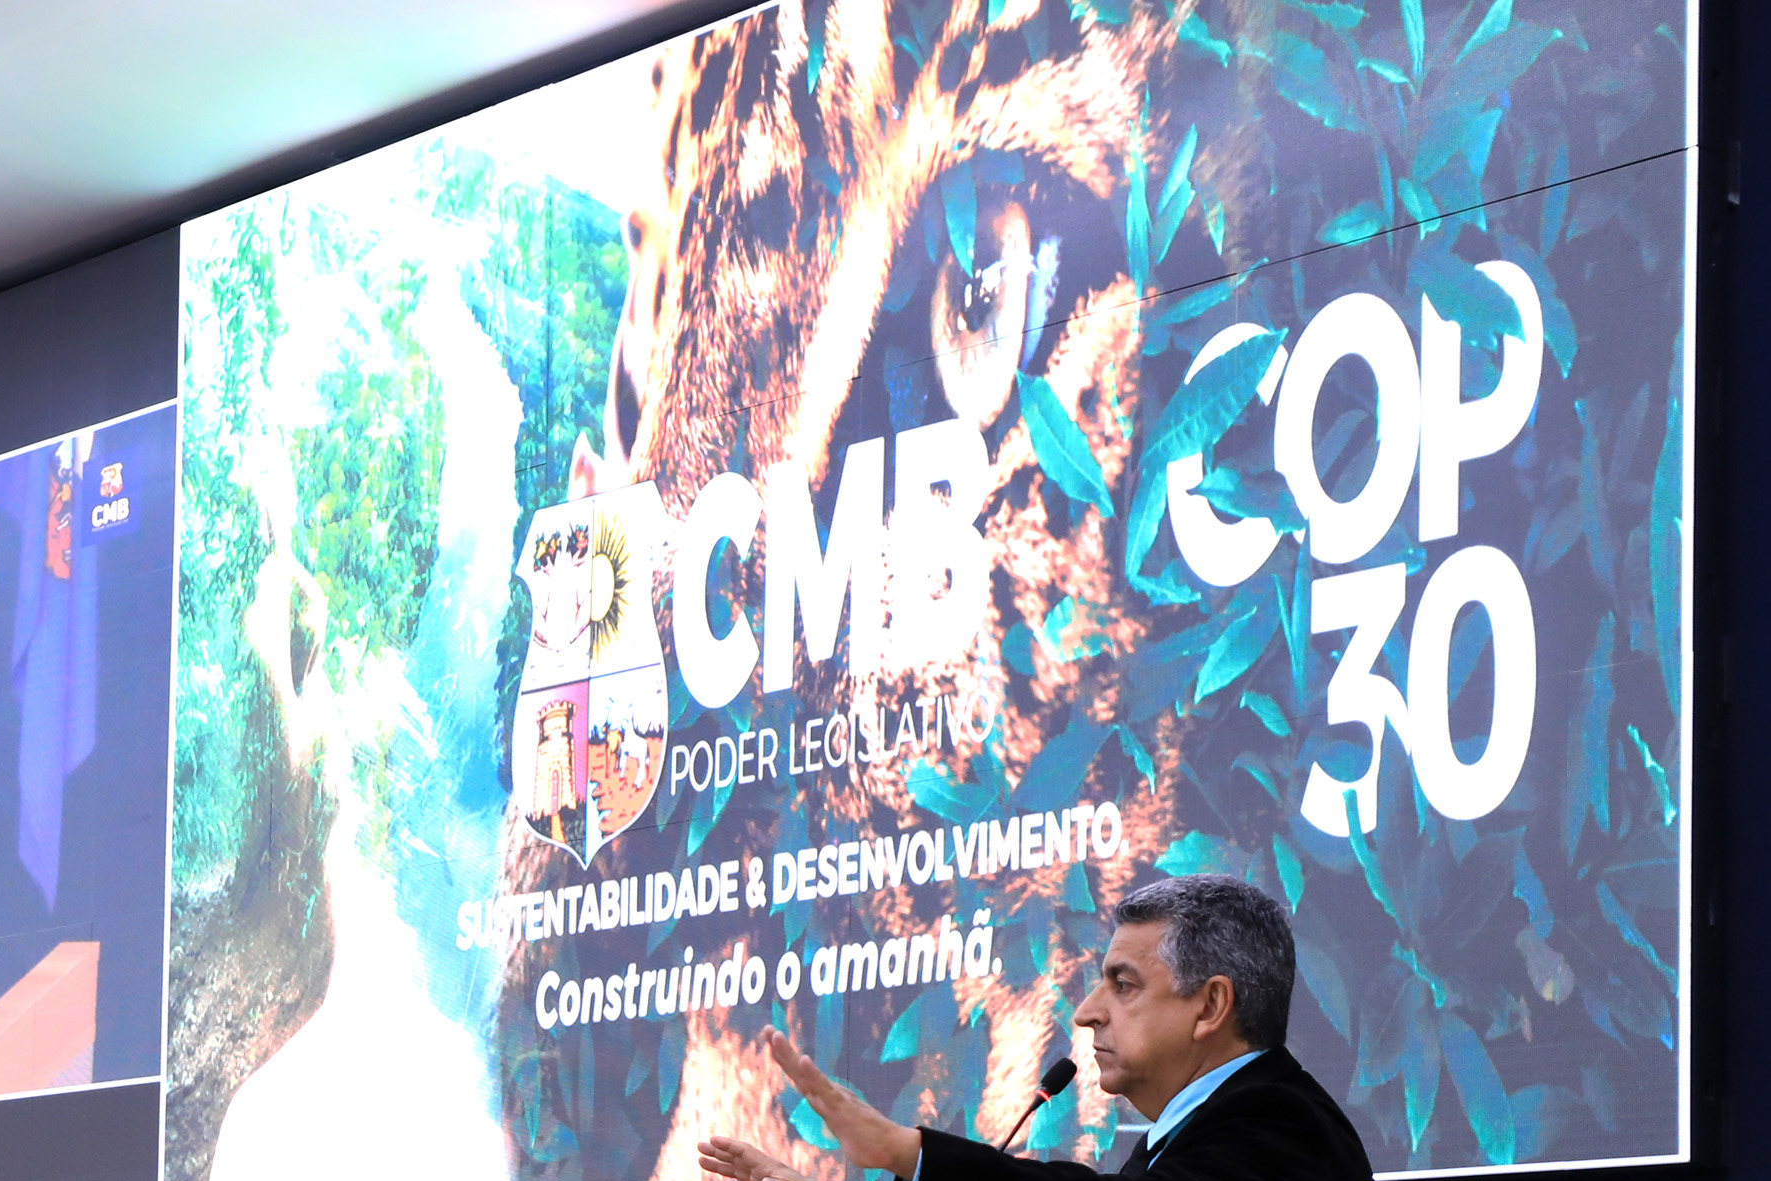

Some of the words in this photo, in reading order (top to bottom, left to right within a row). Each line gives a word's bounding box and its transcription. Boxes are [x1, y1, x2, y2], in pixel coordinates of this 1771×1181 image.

[1166, 260, 1544, 588] COP
[91, 498, 130, 528] CMB
[672, 417, 991, 709] CMB
[670, 726, 778, 796] PODER
[789, 687, 996, 776] LEGISLATIVO
[1299, 545, 1537, 839] 30
[455, 857, 739, 951] SUSTENTABILIDADE
[744, 854, 768, 909] &
[771, 800, 1130, 904] DESENVOLVIMENTO.
[534, 936, 768, 1030] Construindo
[775, 954, 803, 1001] o
[808, 907, 1004, 998] amanhã.
